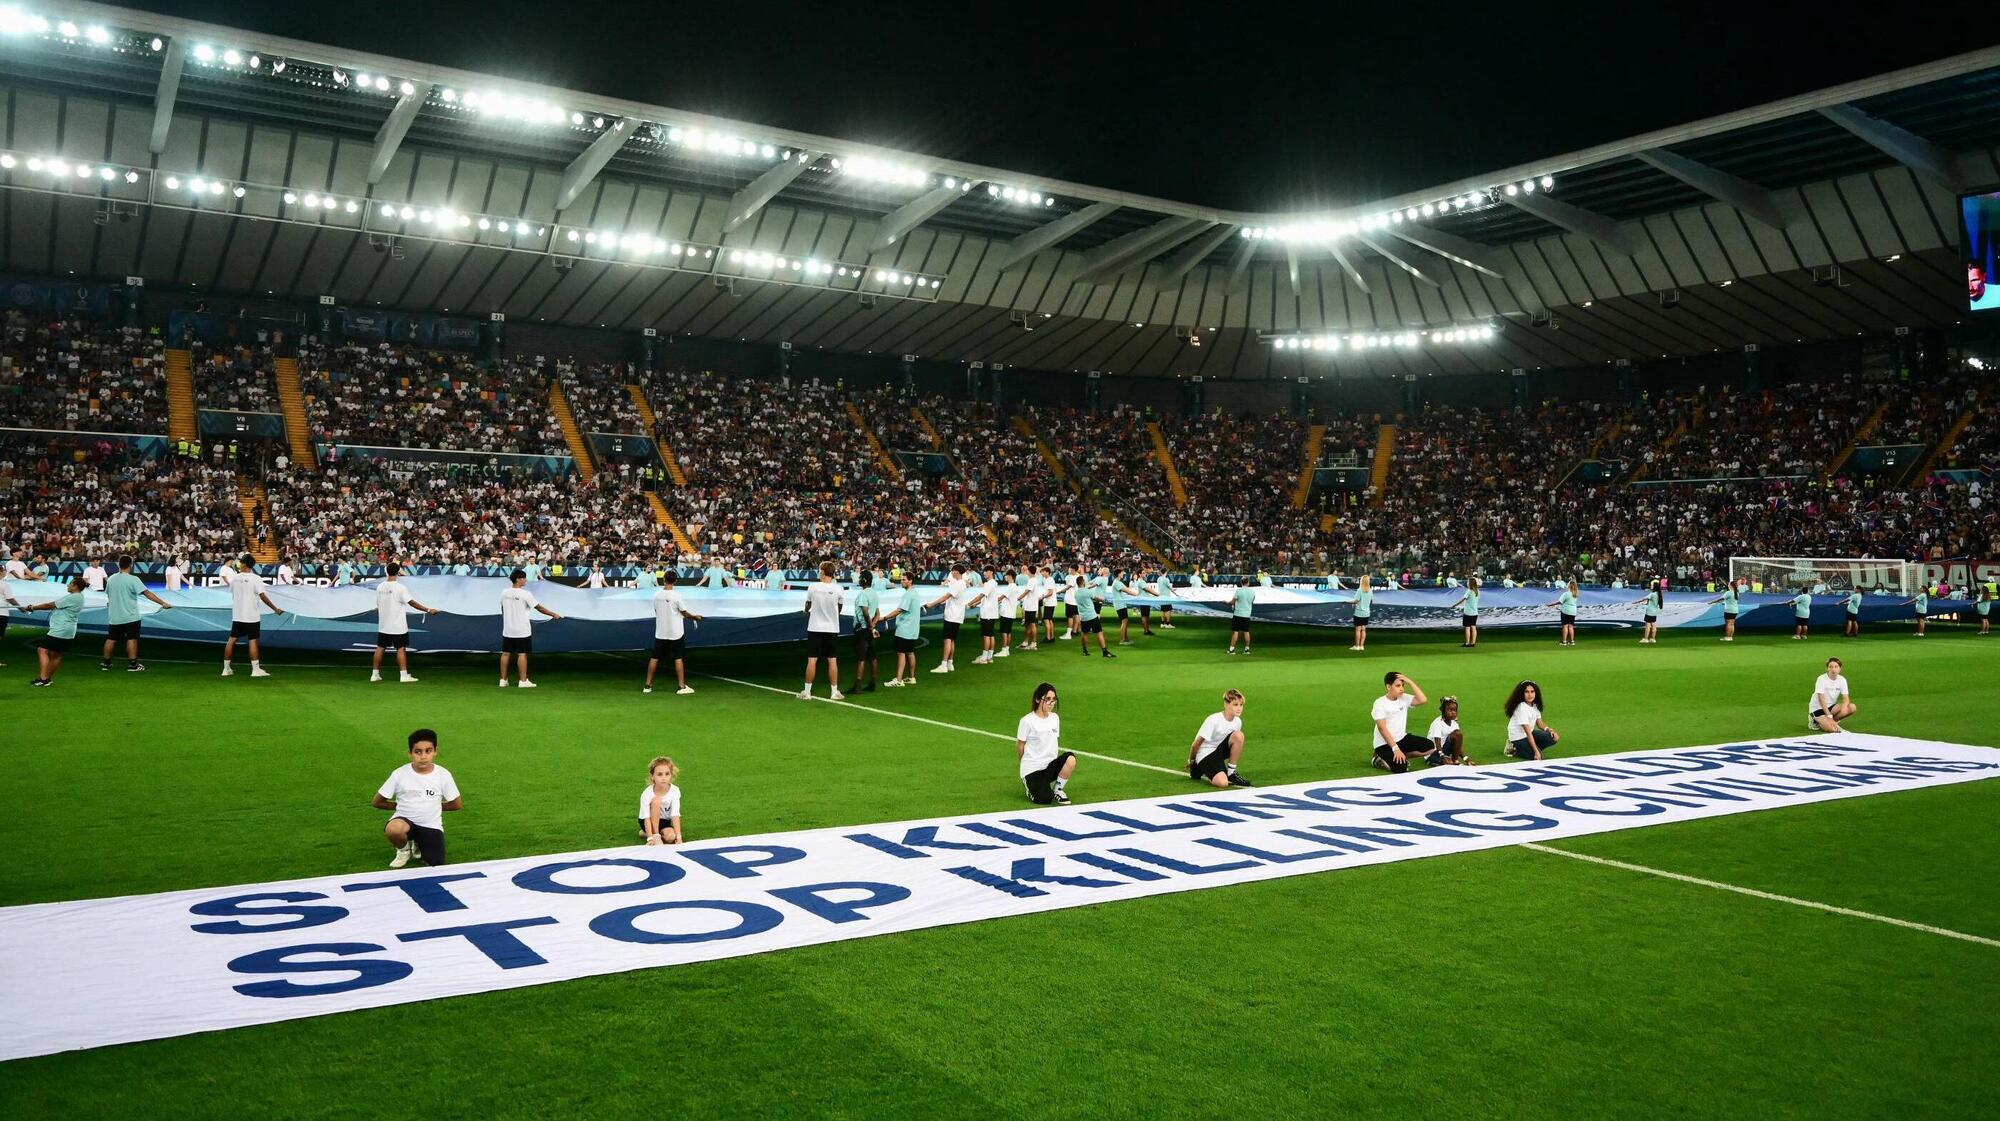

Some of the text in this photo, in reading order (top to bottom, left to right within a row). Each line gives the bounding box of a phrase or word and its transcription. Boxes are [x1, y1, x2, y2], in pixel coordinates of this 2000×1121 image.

[189, 741, 1880, 934] STOP KILLING CHILDREN
[227, 881, 911, 998] STOP
[941, 808, 1559, 898] KILLING
